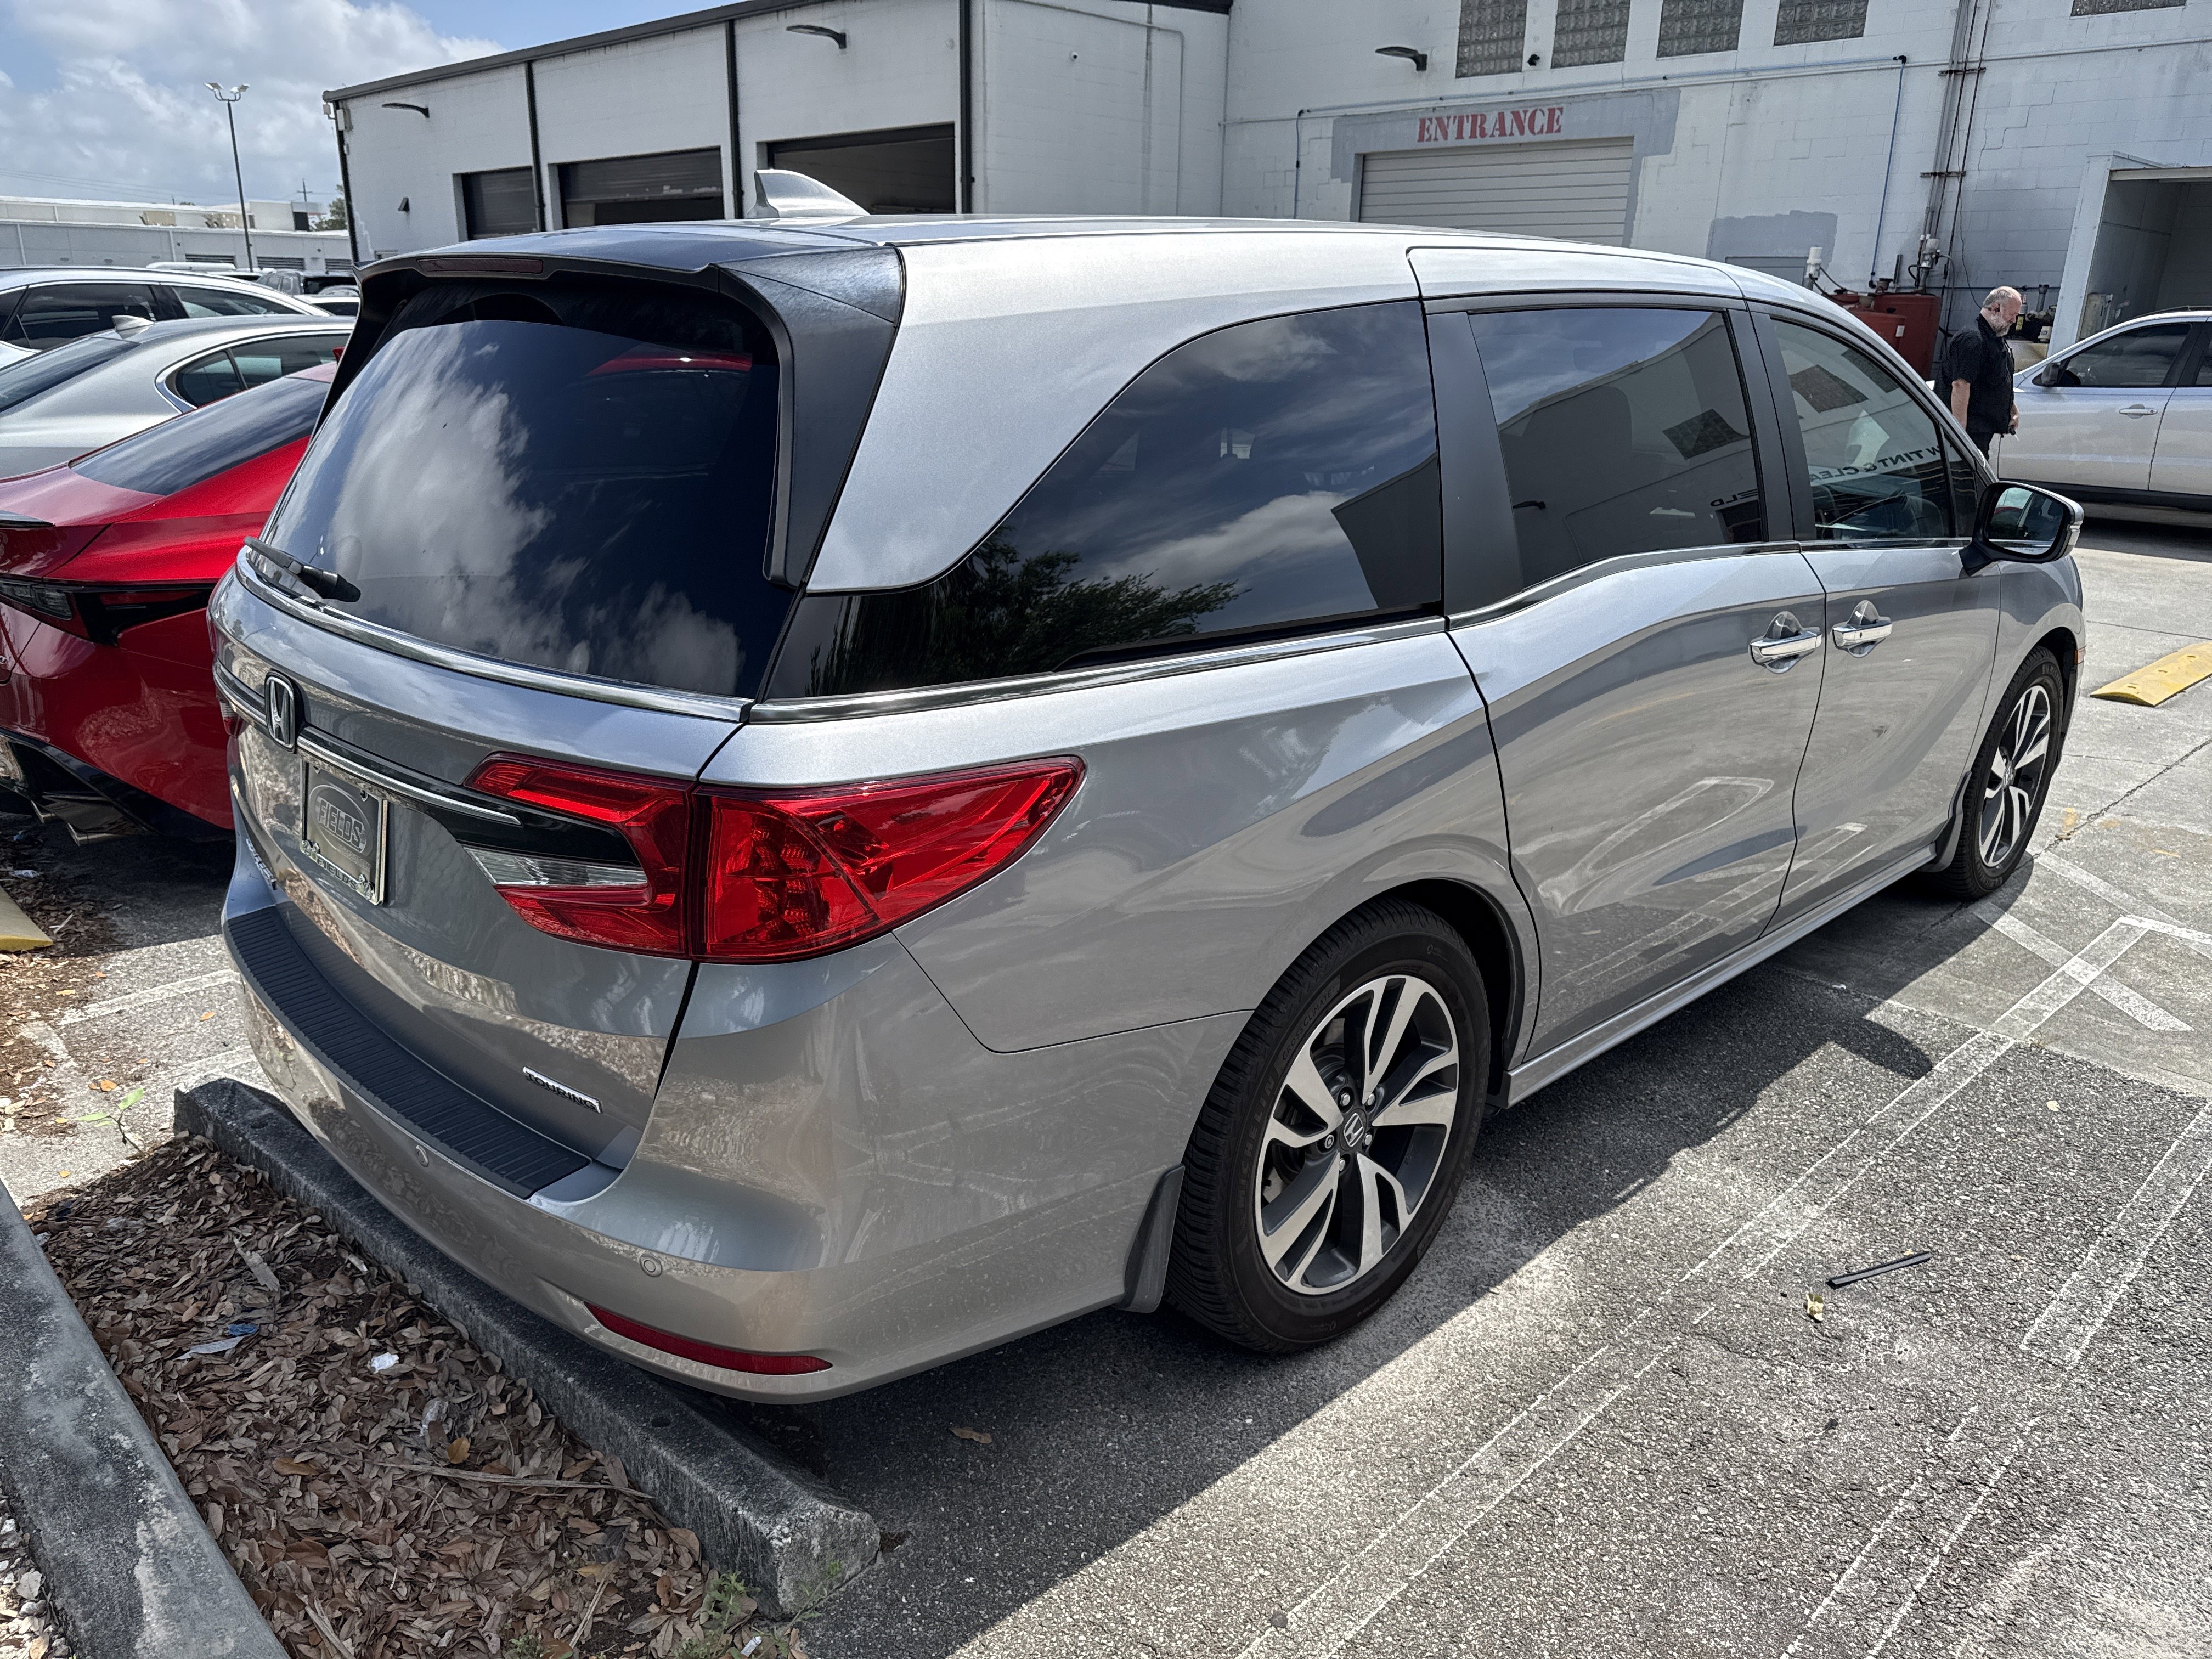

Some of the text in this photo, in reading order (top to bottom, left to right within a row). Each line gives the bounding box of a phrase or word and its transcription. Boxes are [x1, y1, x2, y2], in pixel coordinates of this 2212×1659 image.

[1417, 106, 1564, 143] ENTRANCE
[318, 799, 363, 848] FIELDS
[317, 855, 358, 891] FIELDS
[523, 1066, 602, 1113] TOURING
[1237, 1076, 1274, 1207] MICHELIN
